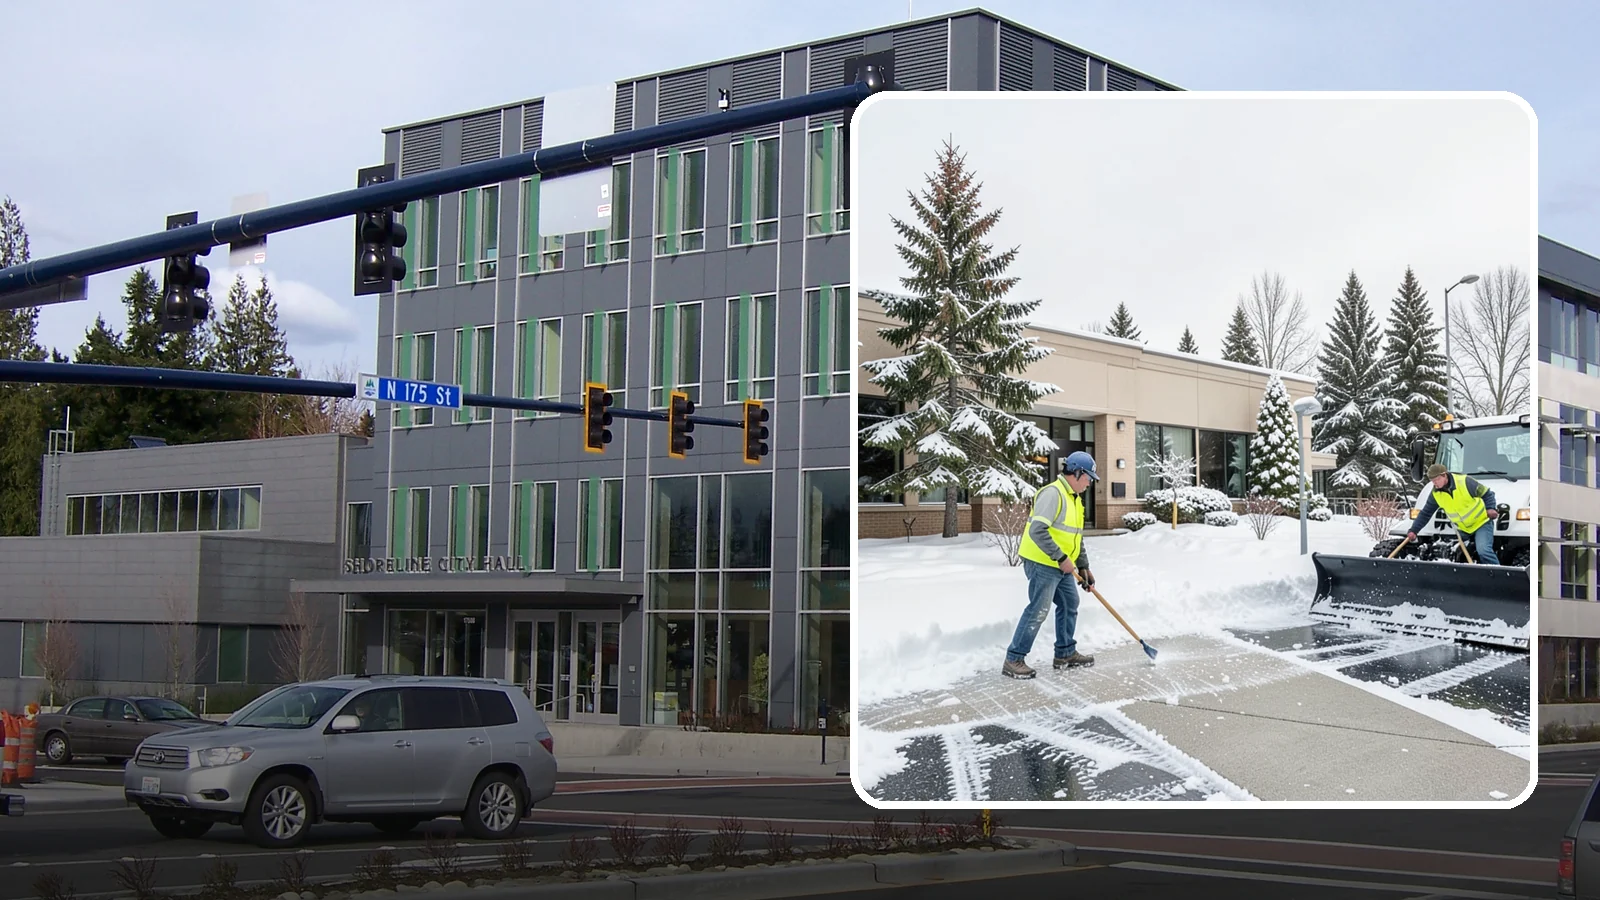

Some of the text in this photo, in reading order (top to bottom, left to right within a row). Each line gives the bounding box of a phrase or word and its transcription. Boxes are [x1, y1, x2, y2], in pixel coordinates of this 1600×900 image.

[387, 380, 451, 406] N 175 St
[344, 555, 525, 574] SHORELINE CITY HALL
